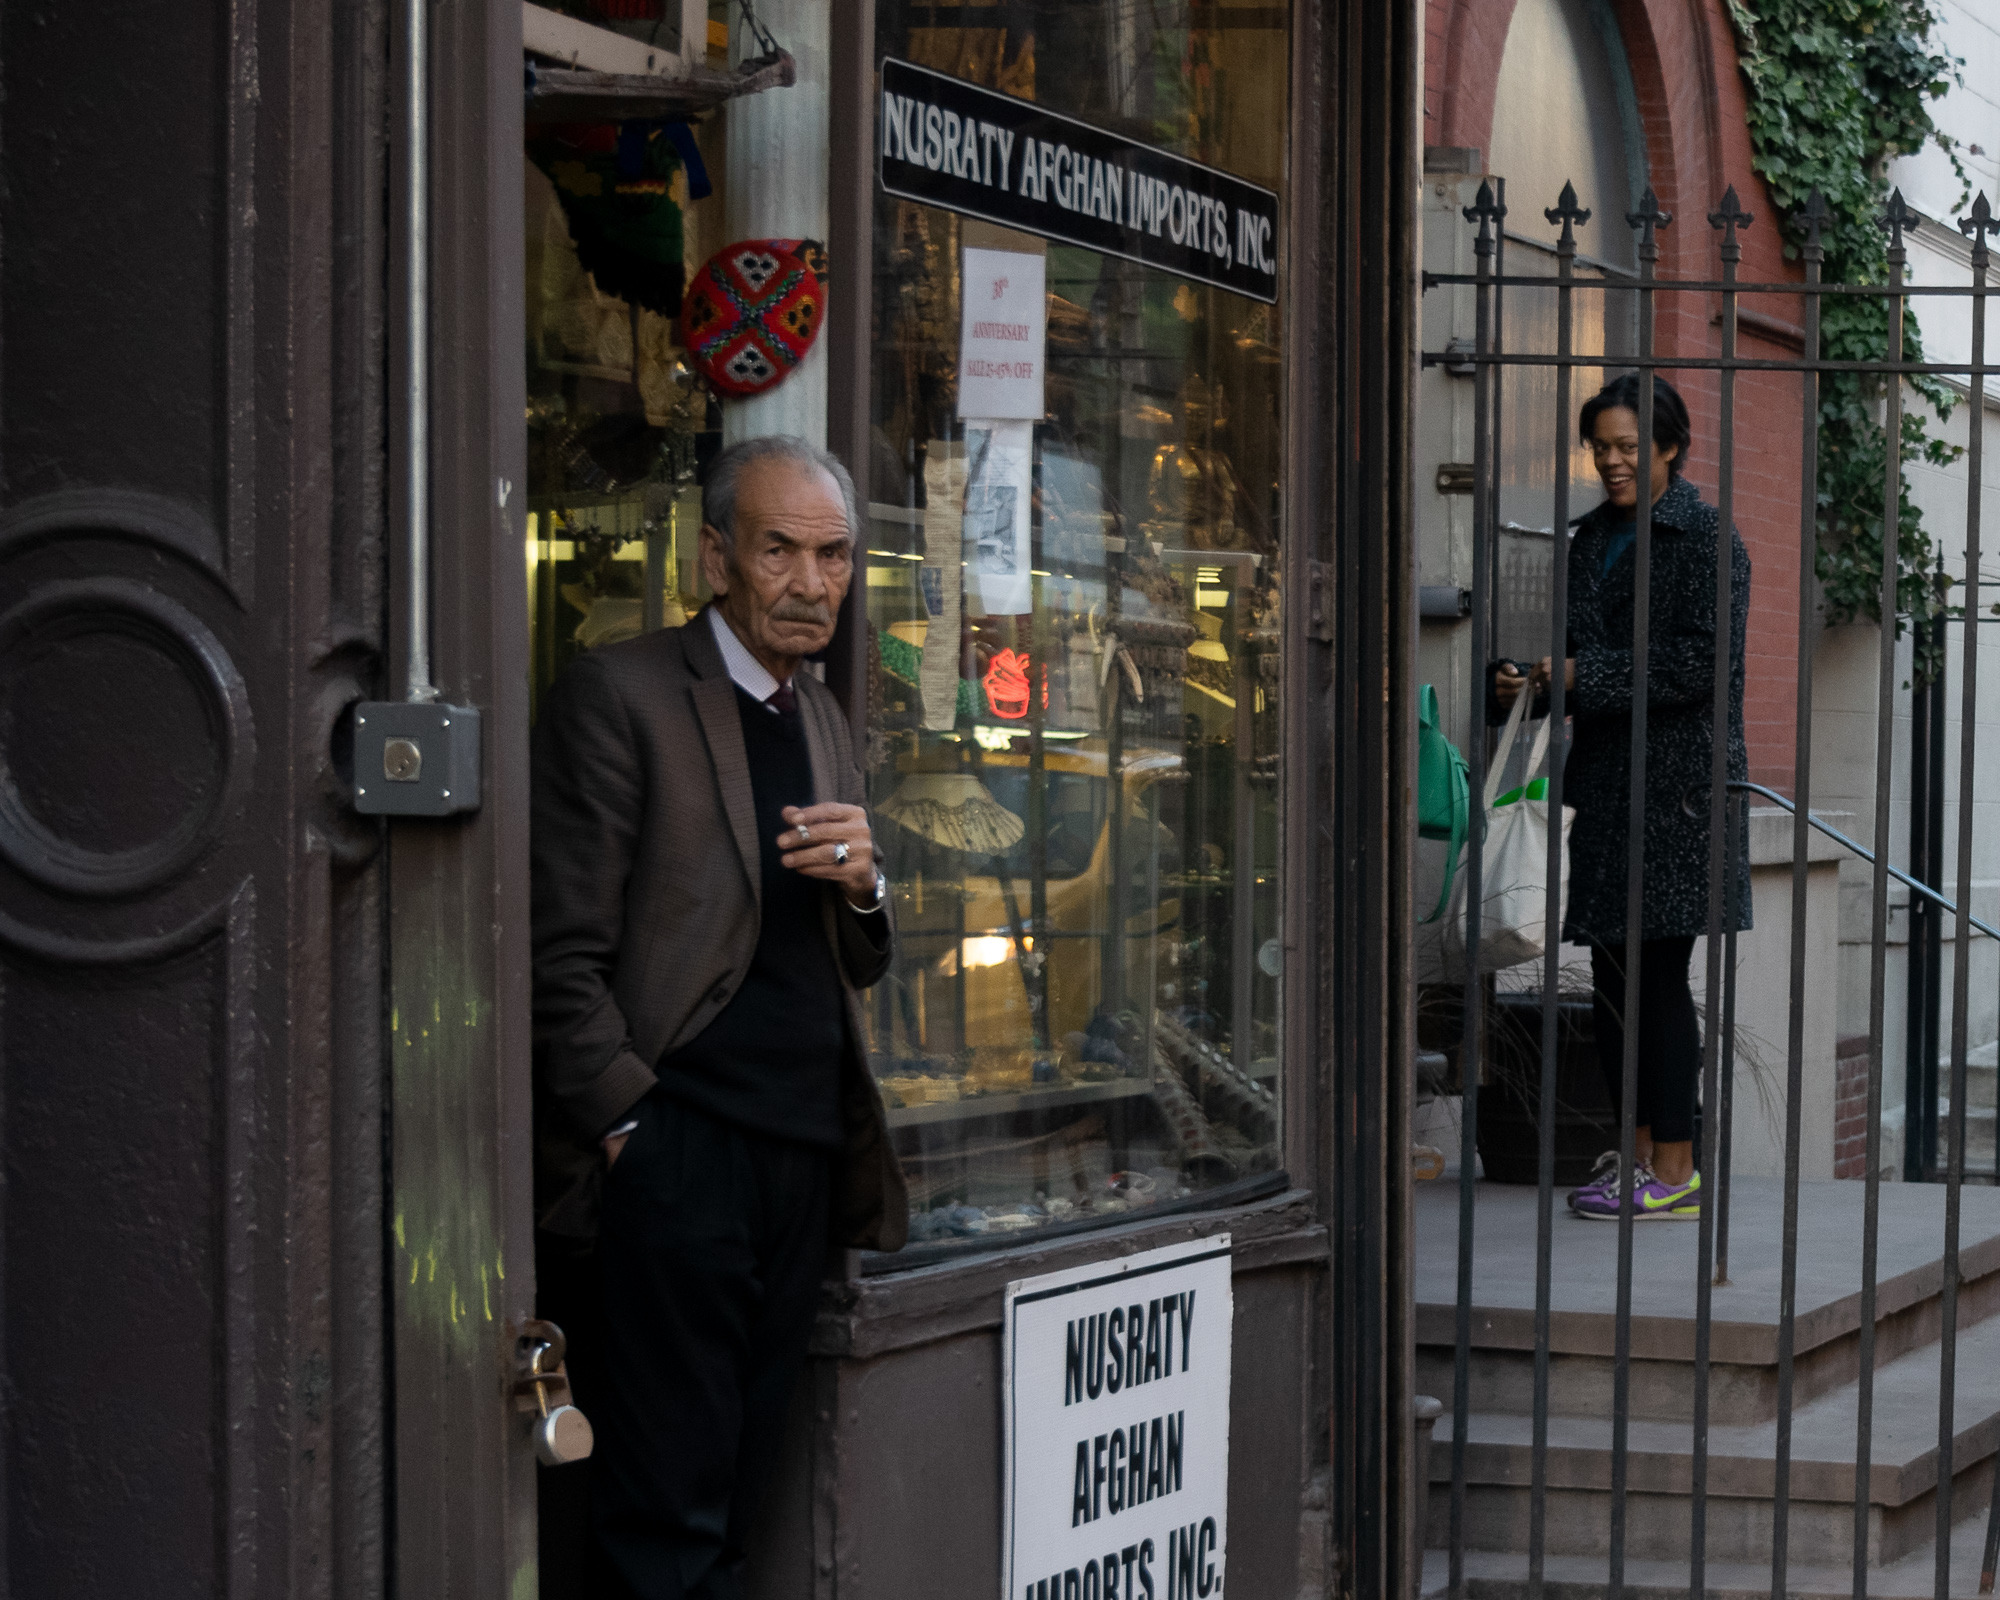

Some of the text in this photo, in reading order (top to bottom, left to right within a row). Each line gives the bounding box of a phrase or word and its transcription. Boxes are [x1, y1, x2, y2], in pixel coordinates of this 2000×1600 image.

[883, 91, 1277, 276] NUSRATY AFGHAN IMPORTS, INC.
[1014, 362, 1033, 379] OFF
[1065, 1289, 1196, 1407] NUSRATY
[1072, 1409, 1185, 1529] AFGHAN
[1026, 1516, 1222, 1600] ORTS INC.
